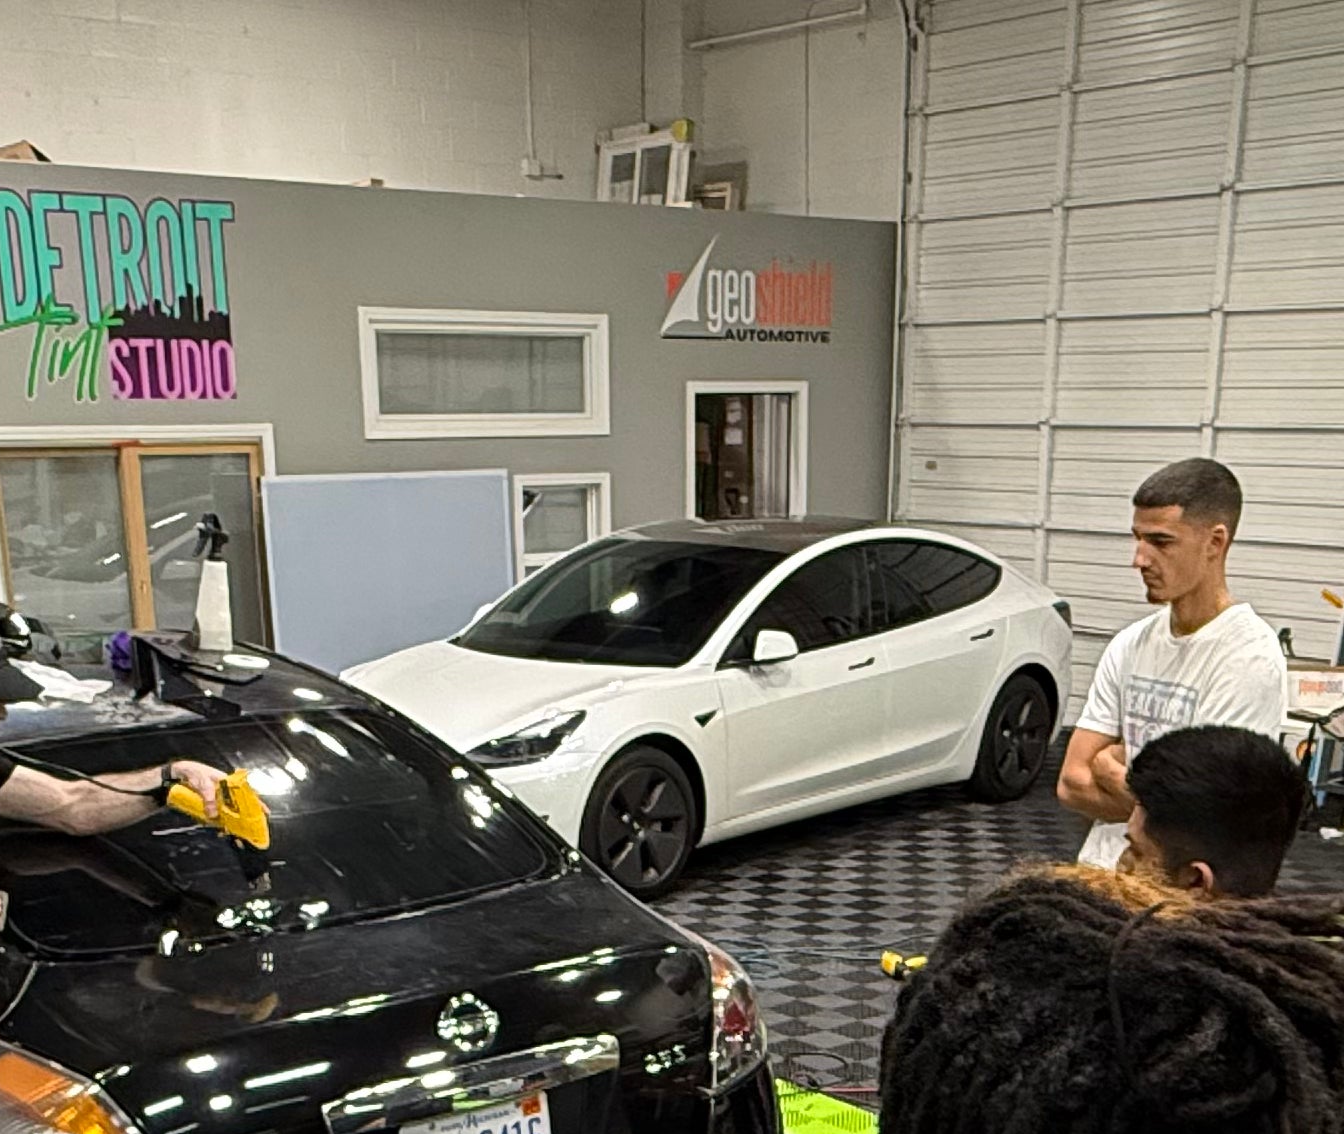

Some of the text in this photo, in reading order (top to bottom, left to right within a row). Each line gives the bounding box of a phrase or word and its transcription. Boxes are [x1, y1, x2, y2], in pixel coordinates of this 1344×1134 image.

[706, 257, 834, 334] geoshield
[722, 327, 832, 344] AUTOMOTIVE
[108, 337, 237, 399] STUDIO
